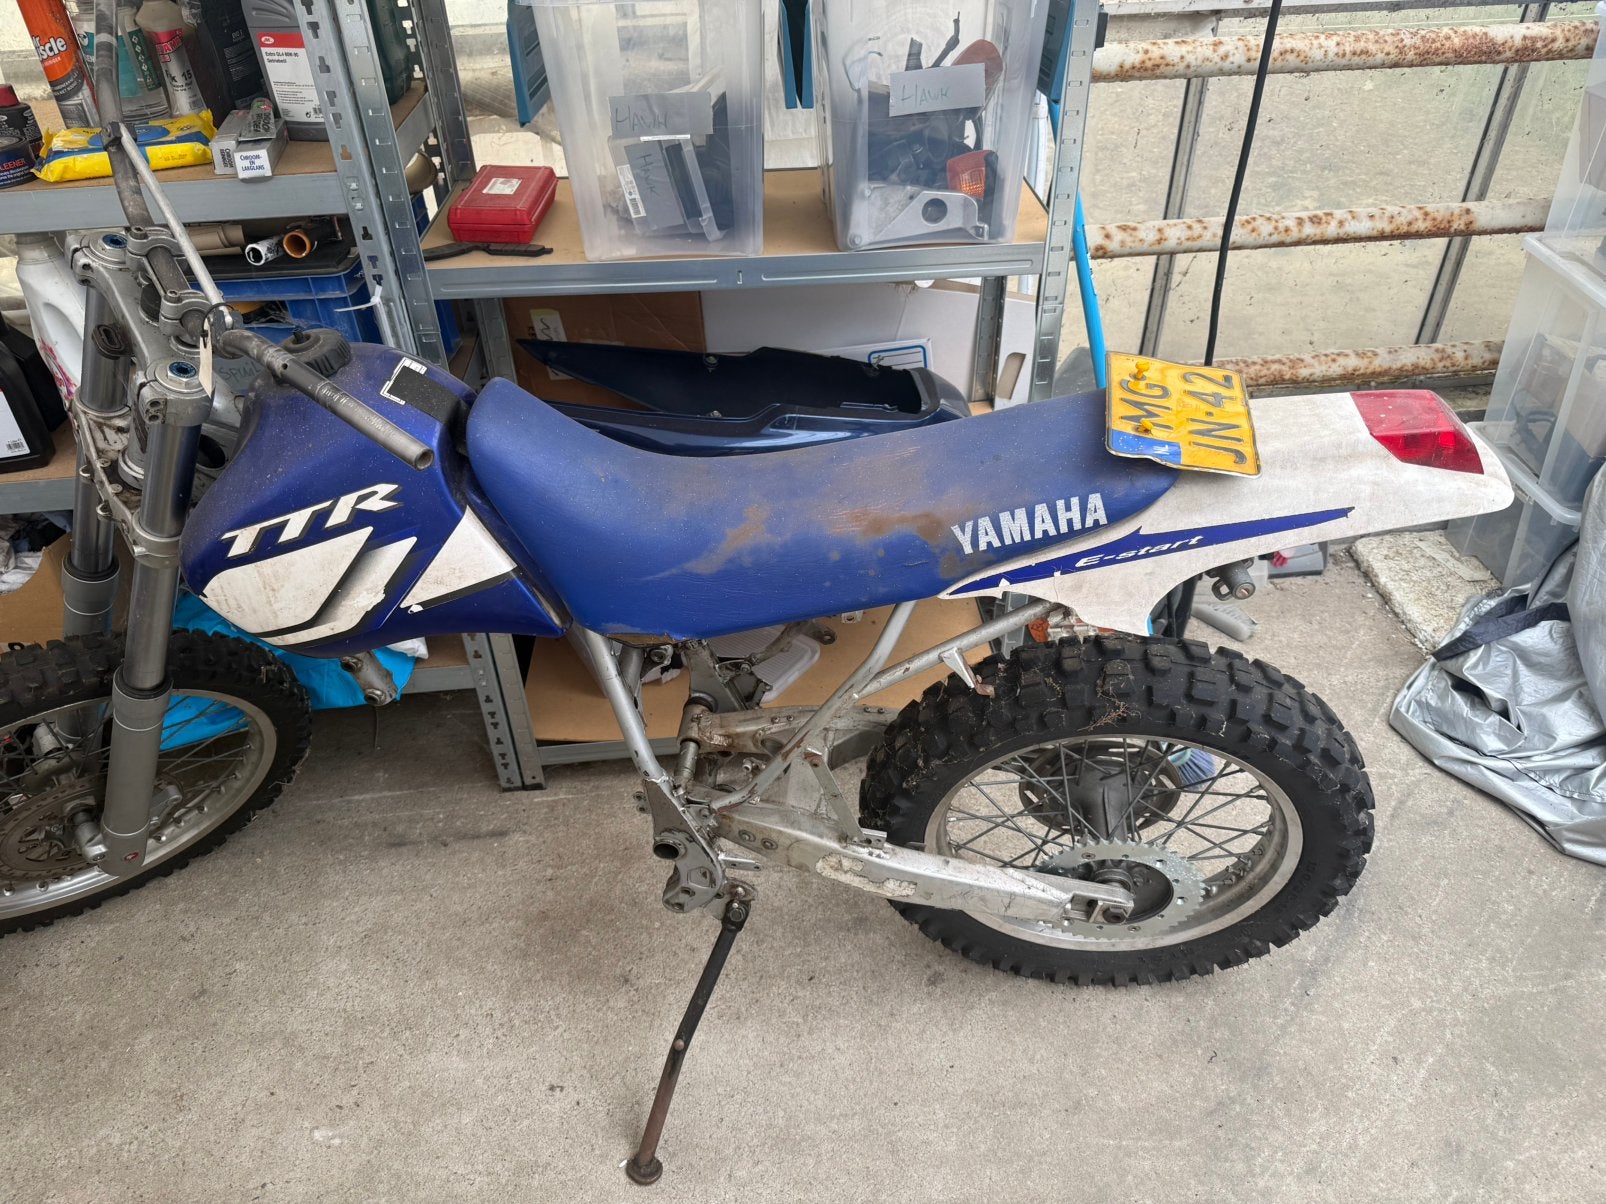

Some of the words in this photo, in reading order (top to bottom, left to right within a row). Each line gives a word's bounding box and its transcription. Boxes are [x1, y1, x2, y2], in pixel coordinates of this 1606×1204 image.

[38, 37, 67, 60] scle
[901, 80, 951, 109] HAWK
[1119, 379, 1173, 431] MG
[1183, 371, 1247, 465] JN-42
[219, 483, 402, 559] TTR
[951, 493, 1108, 555] YAMAHA
[1074, 535, 1205, 568] E-start
